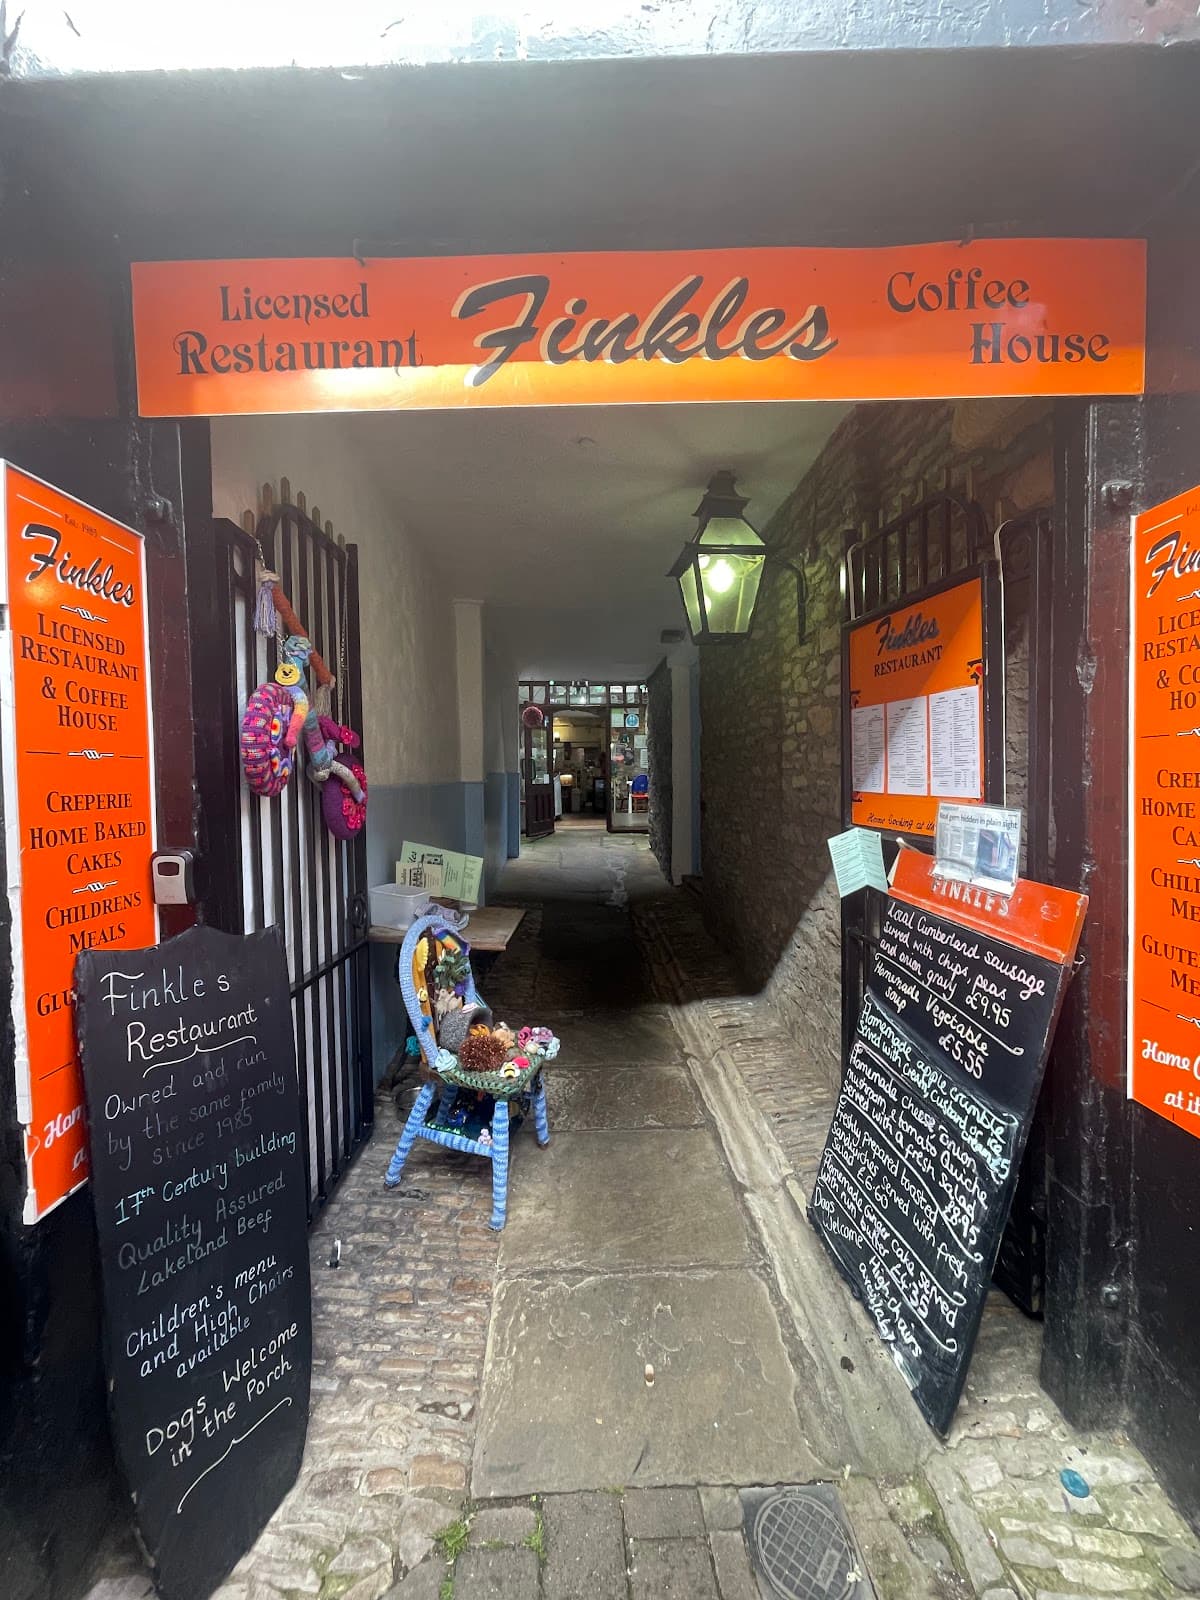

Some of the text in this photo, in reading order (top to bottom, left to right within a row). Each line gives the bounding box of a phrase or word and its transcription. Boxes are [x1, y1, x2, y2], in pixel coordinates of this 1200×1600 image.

[220, 283, 370, 325] Licensed
[887, 267, 1030, 312] Coffee
[451, 274, 838, 387] Finkles
[968, 322, 1110, 365] House
[174, 329, 424, 377] Restaurant
[21, 522, 136, 608] Finkles
[37, 612, 126, 657] LICENSED
[875, 612, 941, 657] Finkles
[20, 635, 140, 683] RESTAURANT
[873, 645, 943, 678] RESTAURANT
[1156, 669, 1170, 690] &
[41, 676, 129, 710] & COFFEE
[1170, 690, 1200, 711] HO
[58, 704, 118, 732] HOUSE
[46, 791, 133, 814] CREPERIE
[1142, 797, 1196, 818] HOME
[30, 820, 147, 850] HOME BAKED
[1172, 826, 1200, 847] CA
[67, 850, 123, 876] CAKES
[45, 891, 142, 931] CHILDRENS
[68, 922, 127, 954] MEALS
[880, 938, 898, 957] and
[1142, 934, 1200, 969] GLUTE
[36, 987, 74, 1017] GLU
[874, 960, 920, 1003] Homemade
[965, 991, 1012, 1028] £9.95
[126, 1003, 259, 1062] Restaurant
[861, 1001, 912, 1062] Homemade
[916, 1060, 948, 1096] apple
[192, 1057, 226, 1088] and
[849, 1048, 898, 1102] Homemade
[938, 1033, 985, 1080] £5.55
[1141, 1038, 1191, 1072] Home
[107, 1070, 287, 1171] by the same family
[1163, 1090, 1184, 1110] at
[152, 1105, 254, 1166] since 1985
[161, 1161, 228, 1203] Century
[234, 1130, 297, 1169] building
[117, 1170, 287, 1271] Quality Assured
[136, 1208, 274, 1296] Lakeland Beef
[126, 1254, 278, 1358] Children's menu
[139, 1332, 181, 1378] and
[193, 1299, 239, 1343] High
[176, 1314, 251, 1379] available
[145, 1320, 299, 1457] Dogs Welcome
[169, 1438, 193, 1468] in
[201, 1400, 238, 1439] the
